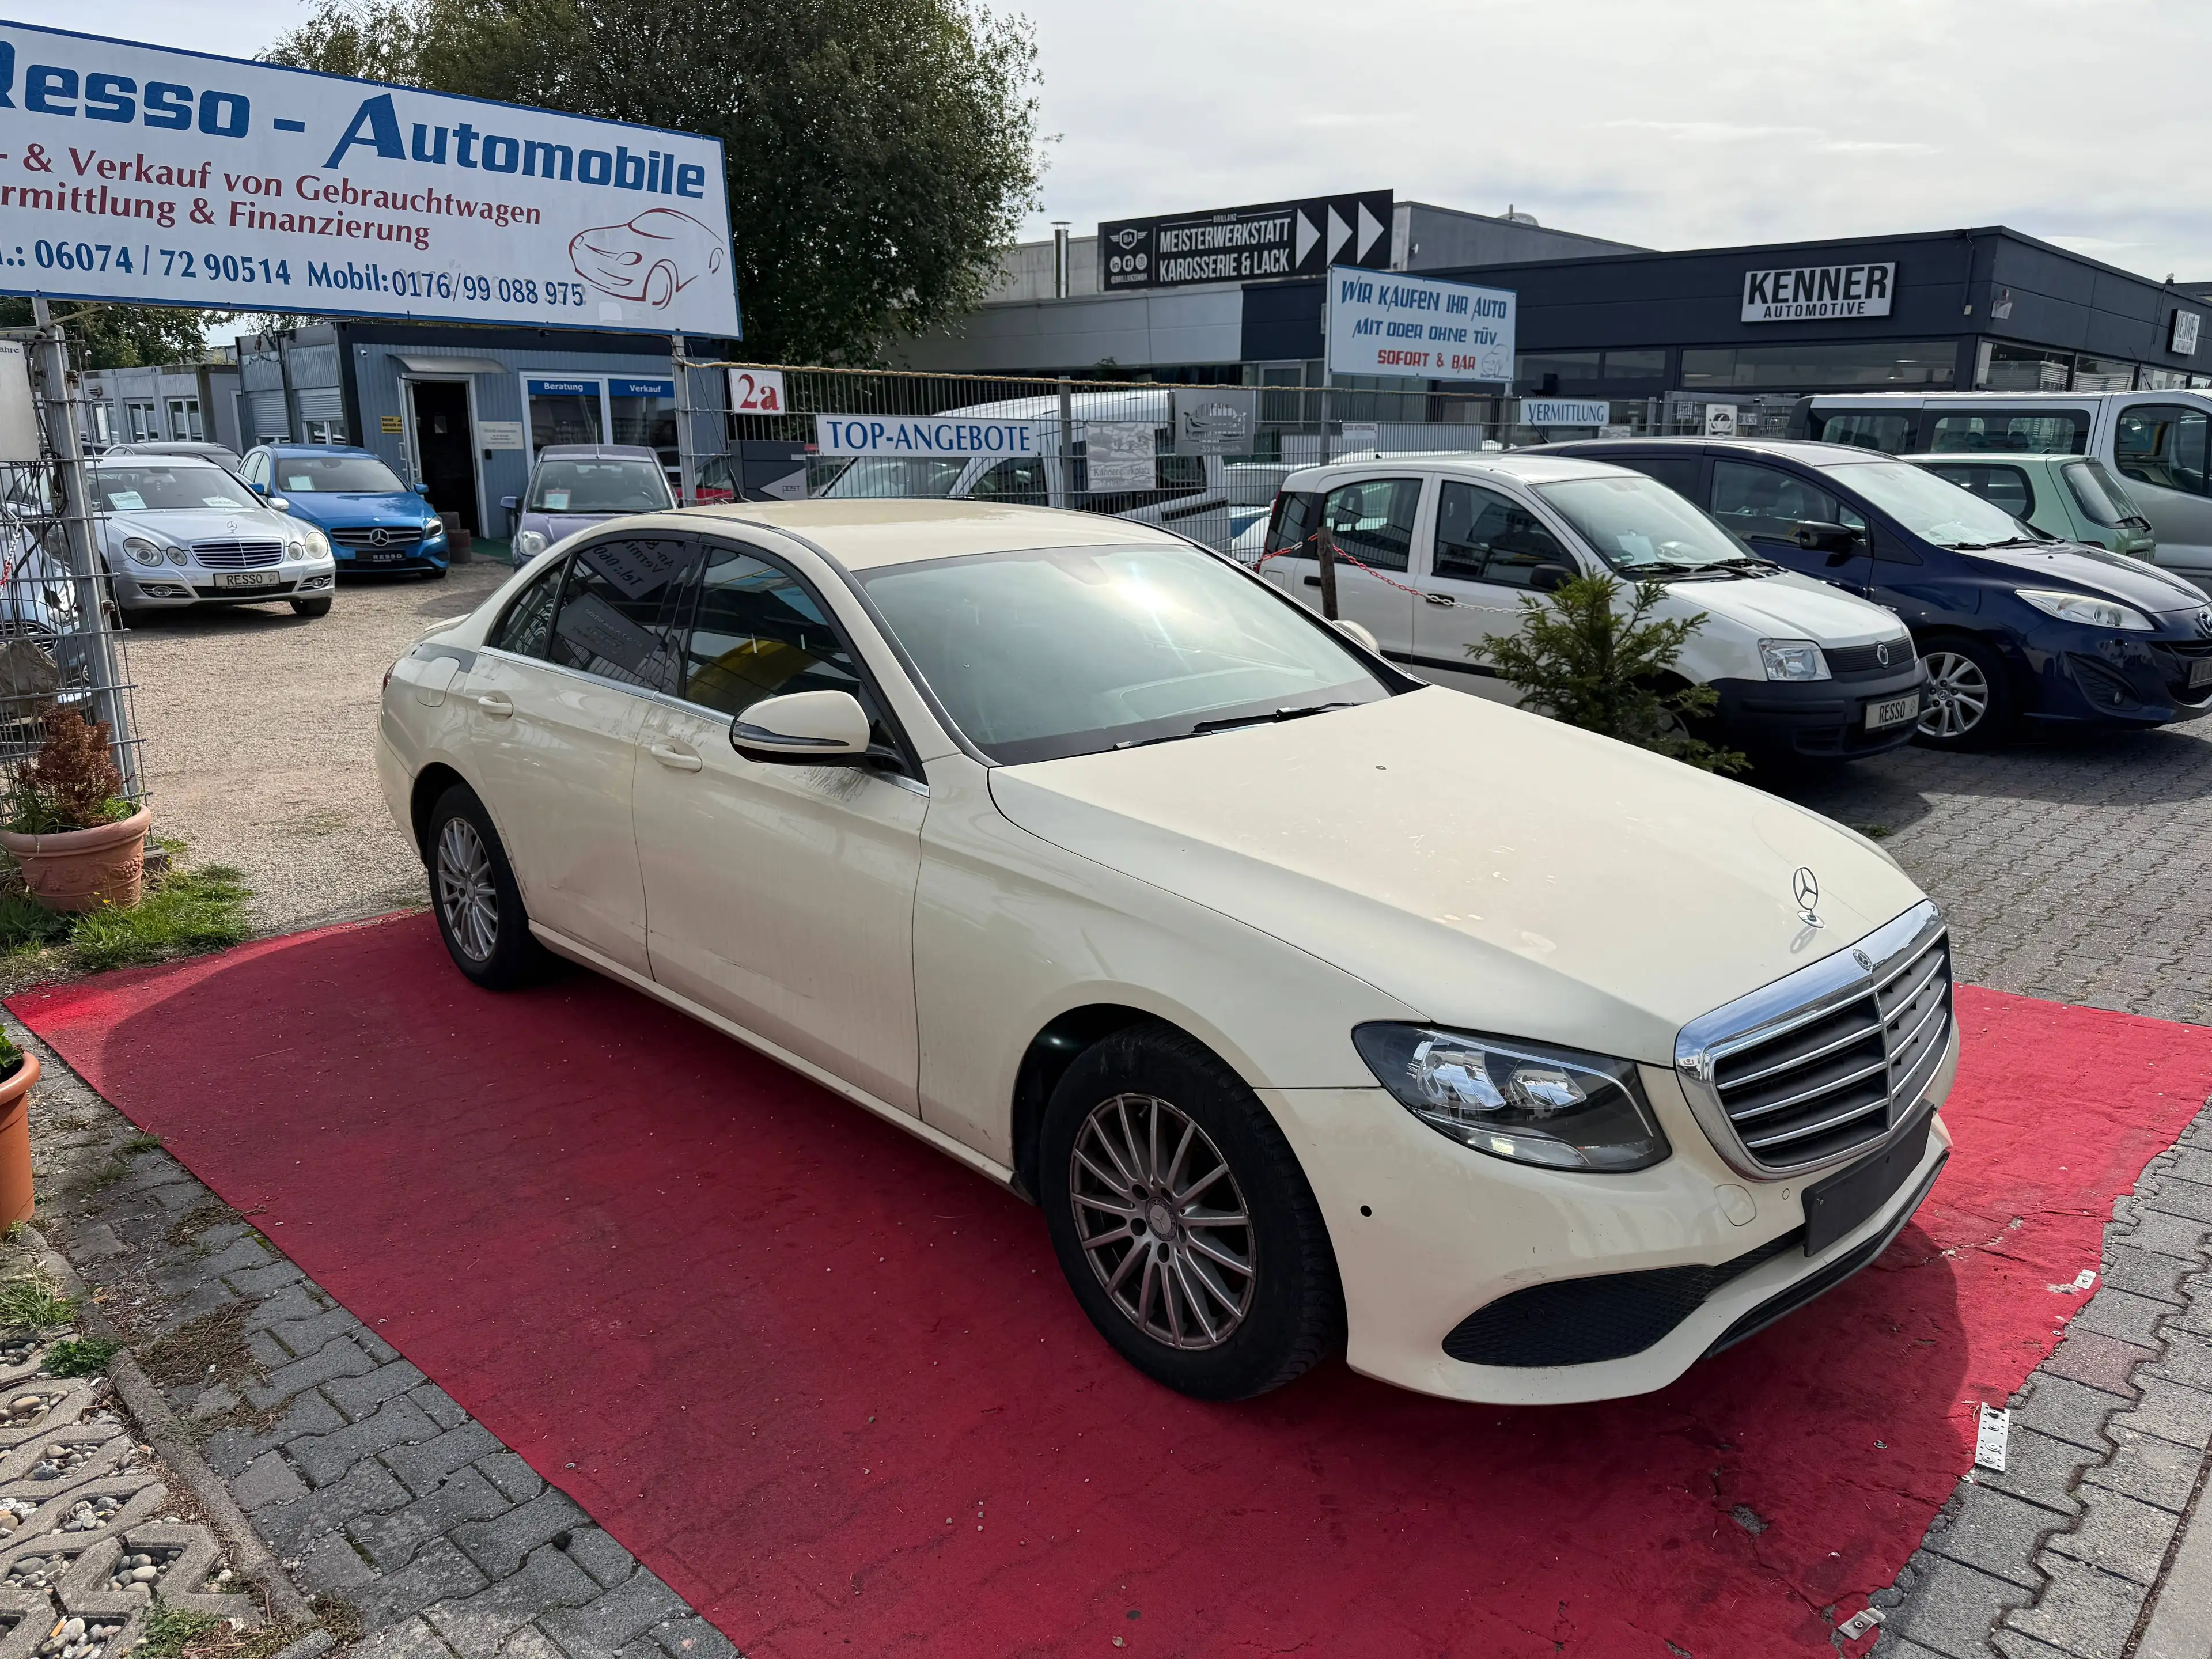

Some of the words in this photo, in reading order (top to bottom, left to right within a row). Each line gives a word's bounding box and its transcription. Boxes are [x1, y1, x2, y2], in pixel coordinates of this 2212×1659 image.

[321, 93, 705, 199] Automobile
[23, 143, 53, 173] &
[69, 147, 211, 190] Verkauf
[224, 173, 282, 197] von
[296, 175, 540, 227] Gebrauchtwagen
[189, 198, 216, 225] &
[229, 201, 430, 250] Finanzierung
[1160, 218, 1291, 253] MEISTERWERKSTATT
[35, 240, 133, 274] 06074
[160, 249, 196, 278] 72
[204, 253, 291, 286] 90514
[498, 278, 539, 304] 088
[545, 281, 584, 307] 975
[1159, 253, 1238, 282] KAROSSERIE
[1241, 252, 1251, 275] &
[1253, 248, 1290, 274] LACK
[1342, 276, 1373, 304] WIR
[1378, 285, 1440, 312] KAUFEN
[1446, 294, 1469, 315] IHR
[1471, 296, 1507, 322] AUTO
[1748, 265, 1888, 305] KENNER
[1763, 301, 1866, 319] AUTOMOTIVE
[1352, 317, 1384, 338] MIT
[1387, 321, 1423, 339] ODER
[1429, 325, 1467, 343] OHNE
[1474, 327, 1497, 346] TÜV
[1377, 349, 1430, 367] SOFORT
[1436, 353, 1444, 368] &
[1452, 354, 1476, 374] BAR
[544, 382, 584, 392] Beratung
[738, 374, 779, 411] 2a
[1528, 404, 1604, 422] VERMITTLUNG
[827, 421, 1030, 451] TOP-ANGEBOTE
[226, 574, 263, 585] RESSO
[1878, 700, 1906, 724] RESSO
